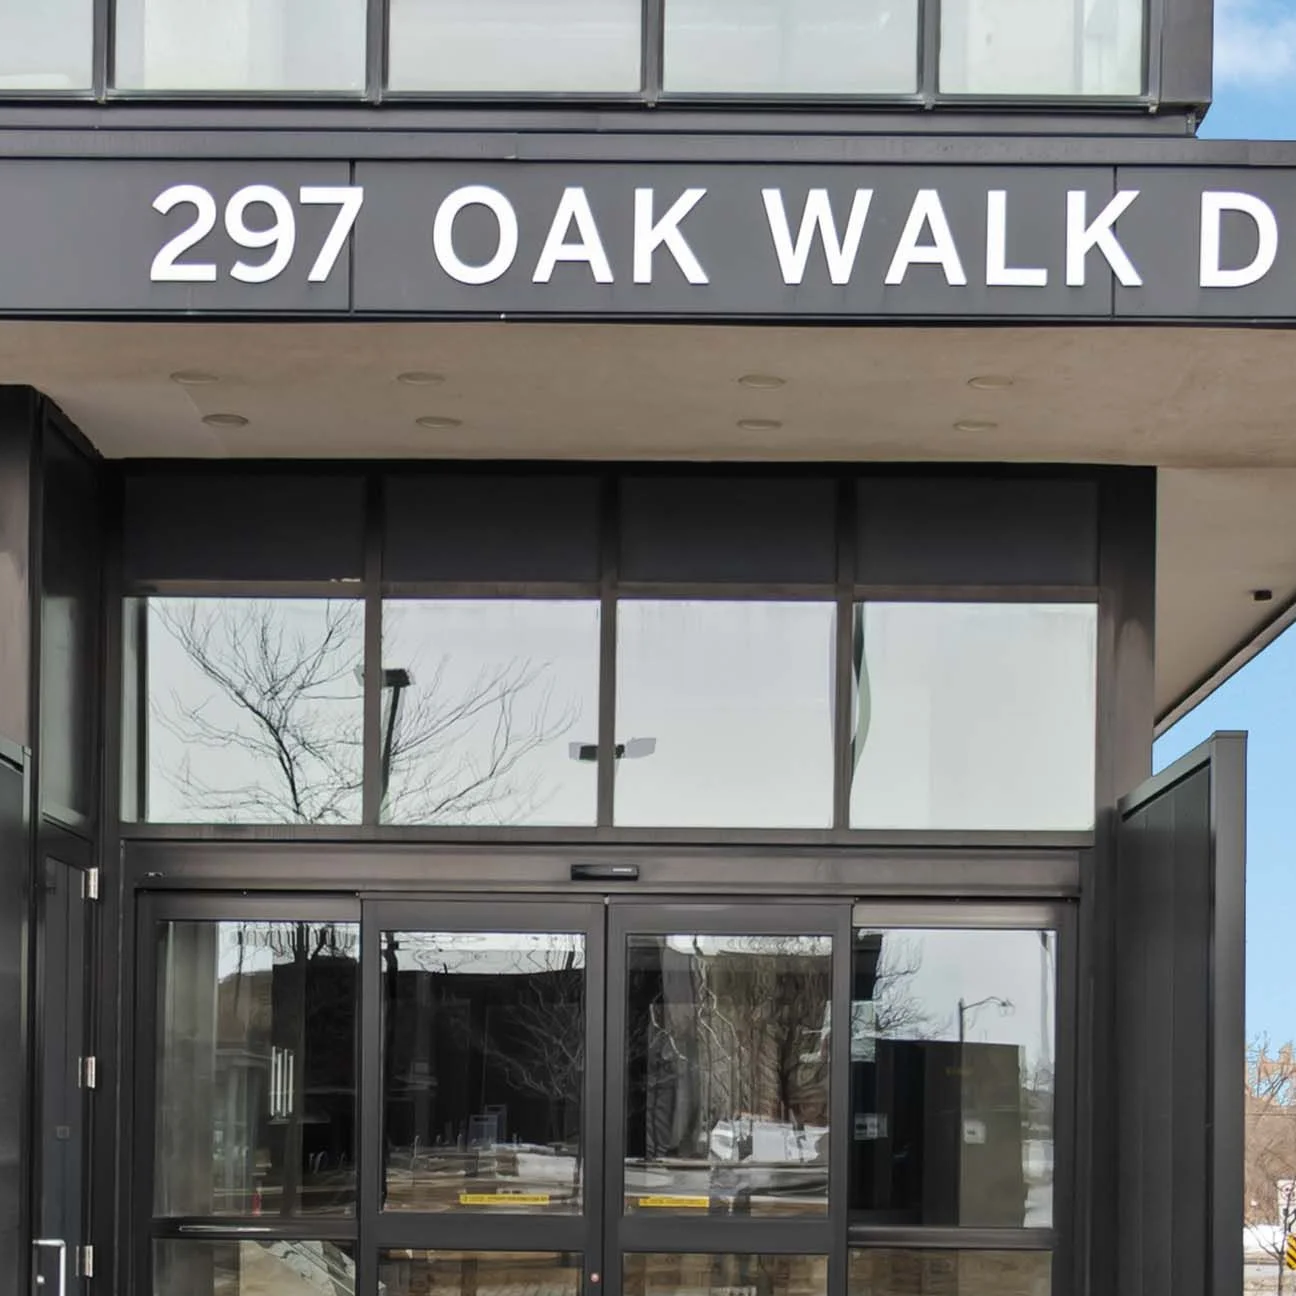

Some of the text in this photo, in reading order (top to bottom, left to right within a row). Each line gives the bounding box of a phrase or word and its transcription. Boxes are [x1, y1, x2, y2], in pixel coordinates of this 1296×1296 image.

[150, 184, 364, 283] 297
[433, 185, 710, 285] OAK
[761, 187, 1143, 287] WALK
